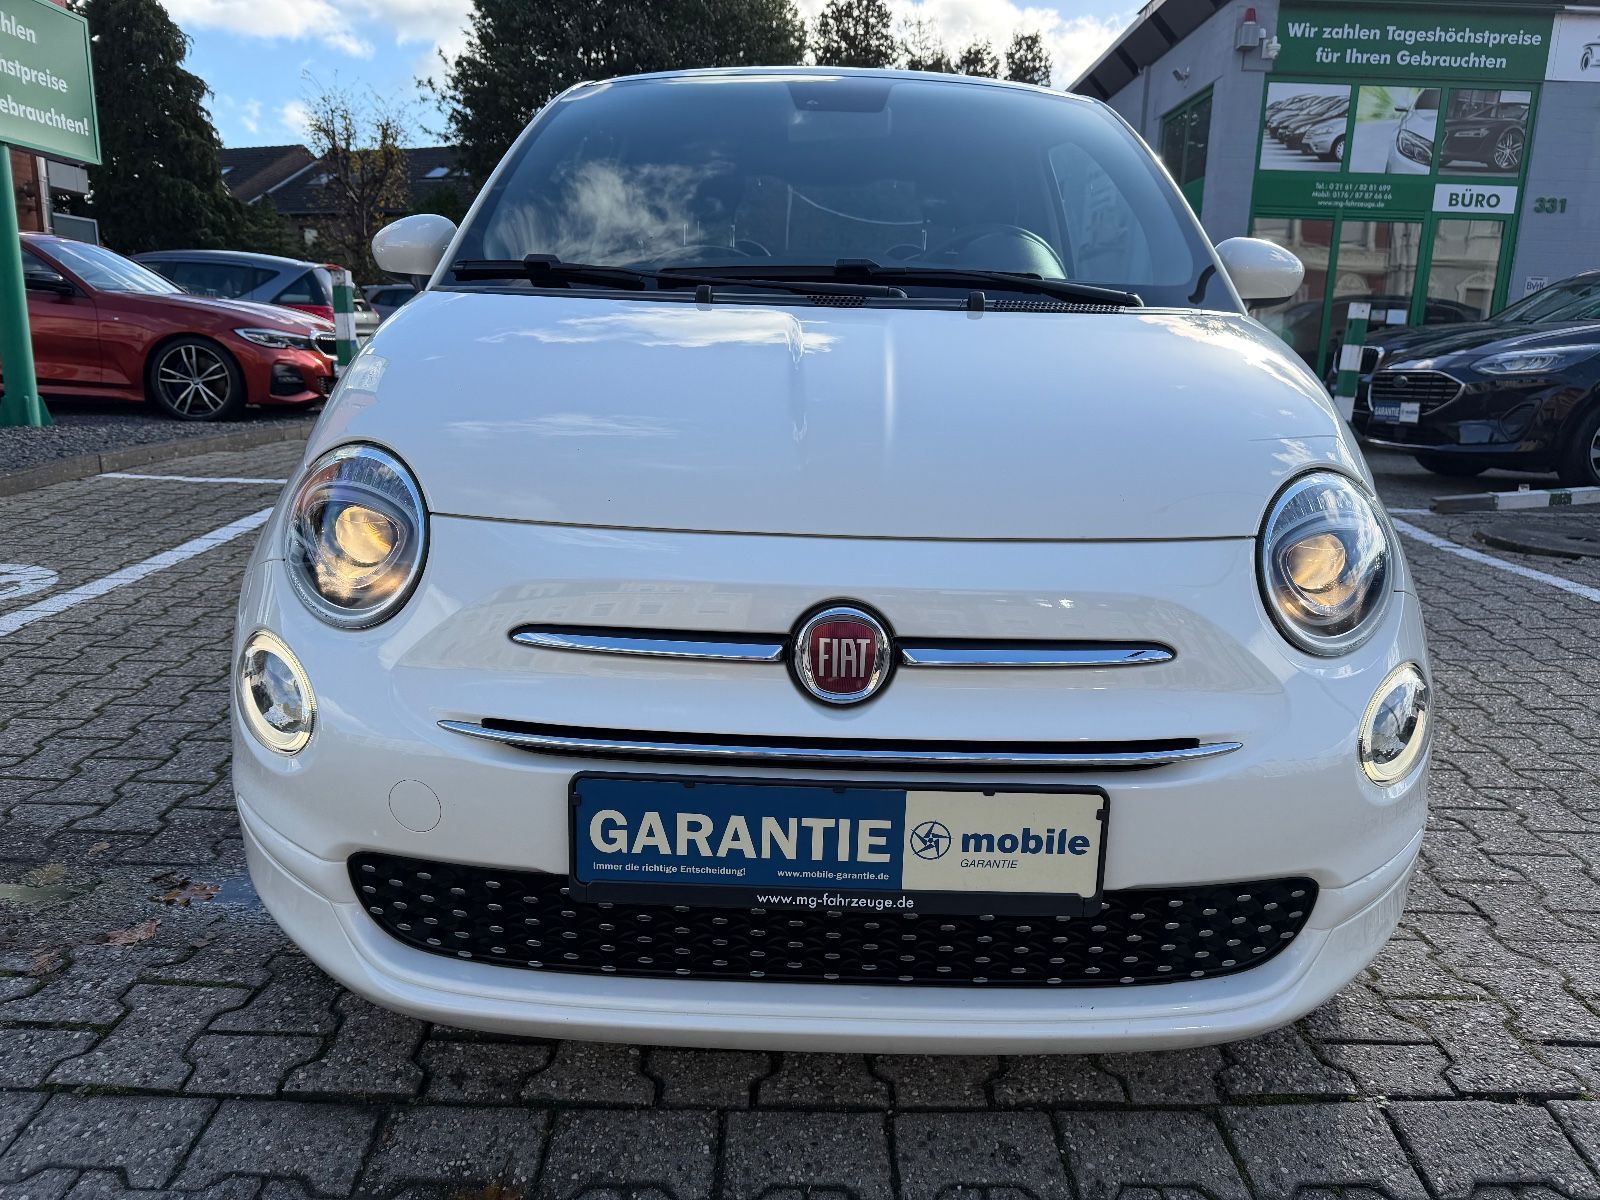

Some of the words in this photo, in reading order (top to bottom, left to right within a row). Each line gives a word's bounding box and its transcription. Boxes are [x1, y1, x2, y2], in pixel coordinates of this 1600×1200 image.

[0, 10, 37, 43] hlen
[1287, 22, 1318, 38] Wir
[1322, 23, 1380, 40] zahlen
[1386, 25, 1542, 48] Tageshöchstpreise
[1315, 47, 1341, 63] für
[1345, 48, 1391, 65] Ihren
[1396, 50, 1507, 68] Gebrauchten
[1448, 188, 1501, 208] BÜRO
[1534, 197, 1567, 214] 331
[818, 637, 871, 678] FIAT
[589, 809, 892, 863] GARANTIE
[961, 827, 1091, 856] mobile
[593, 861, 623, 871] Immer
[625, 863, 640, 871] die
[642, 863, 678, 874] richtige
[680, 865, 746, 877] Entscheidung!
[960, 858, 1019, 869] GARANTIE
[777, 869, 890, 881] www.mobile-garantie.de
[756, 892, 915, 911] www.mg-fahrzeuge.de
